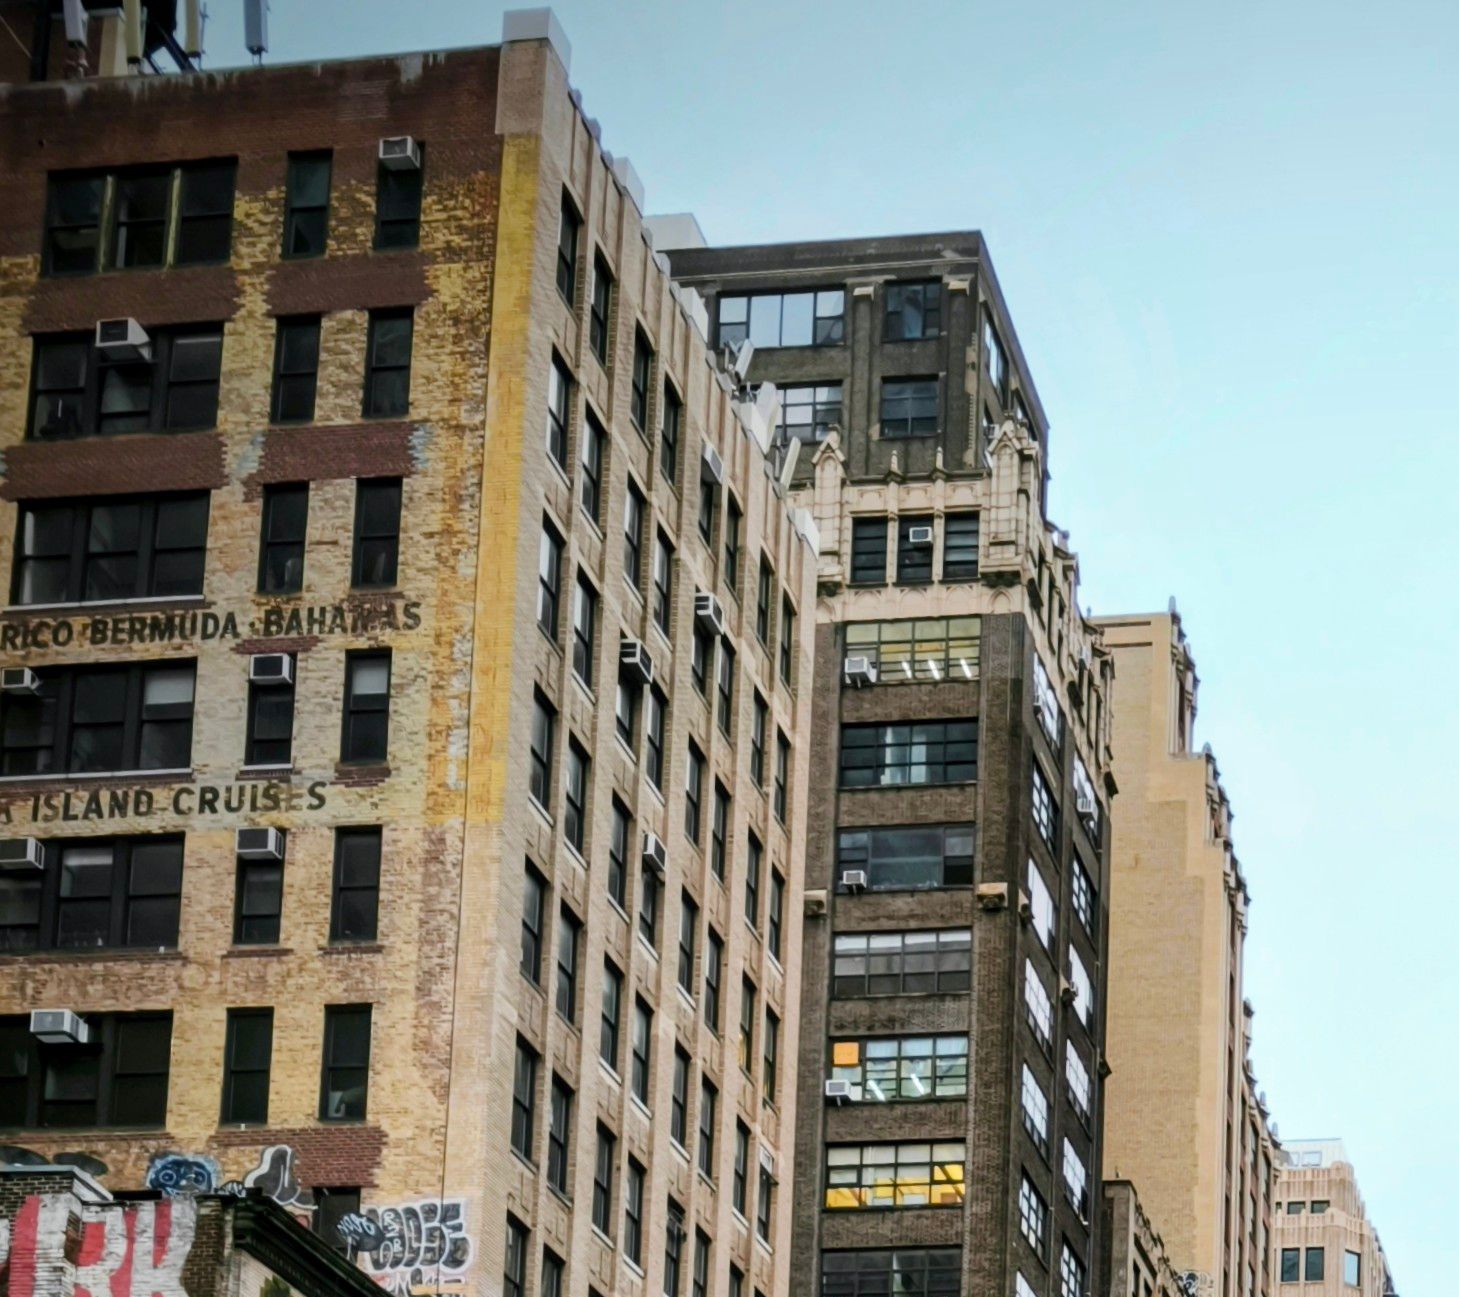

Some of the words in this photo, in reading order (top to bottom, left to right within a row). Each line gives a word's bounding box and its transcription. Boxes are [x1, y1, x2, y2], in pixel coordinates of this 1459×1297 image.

[89, 612, 240, 645] BERMUDA
[31, 789, 155, 822] ISLAND
[172, 781, 328, 816] CRUISS
